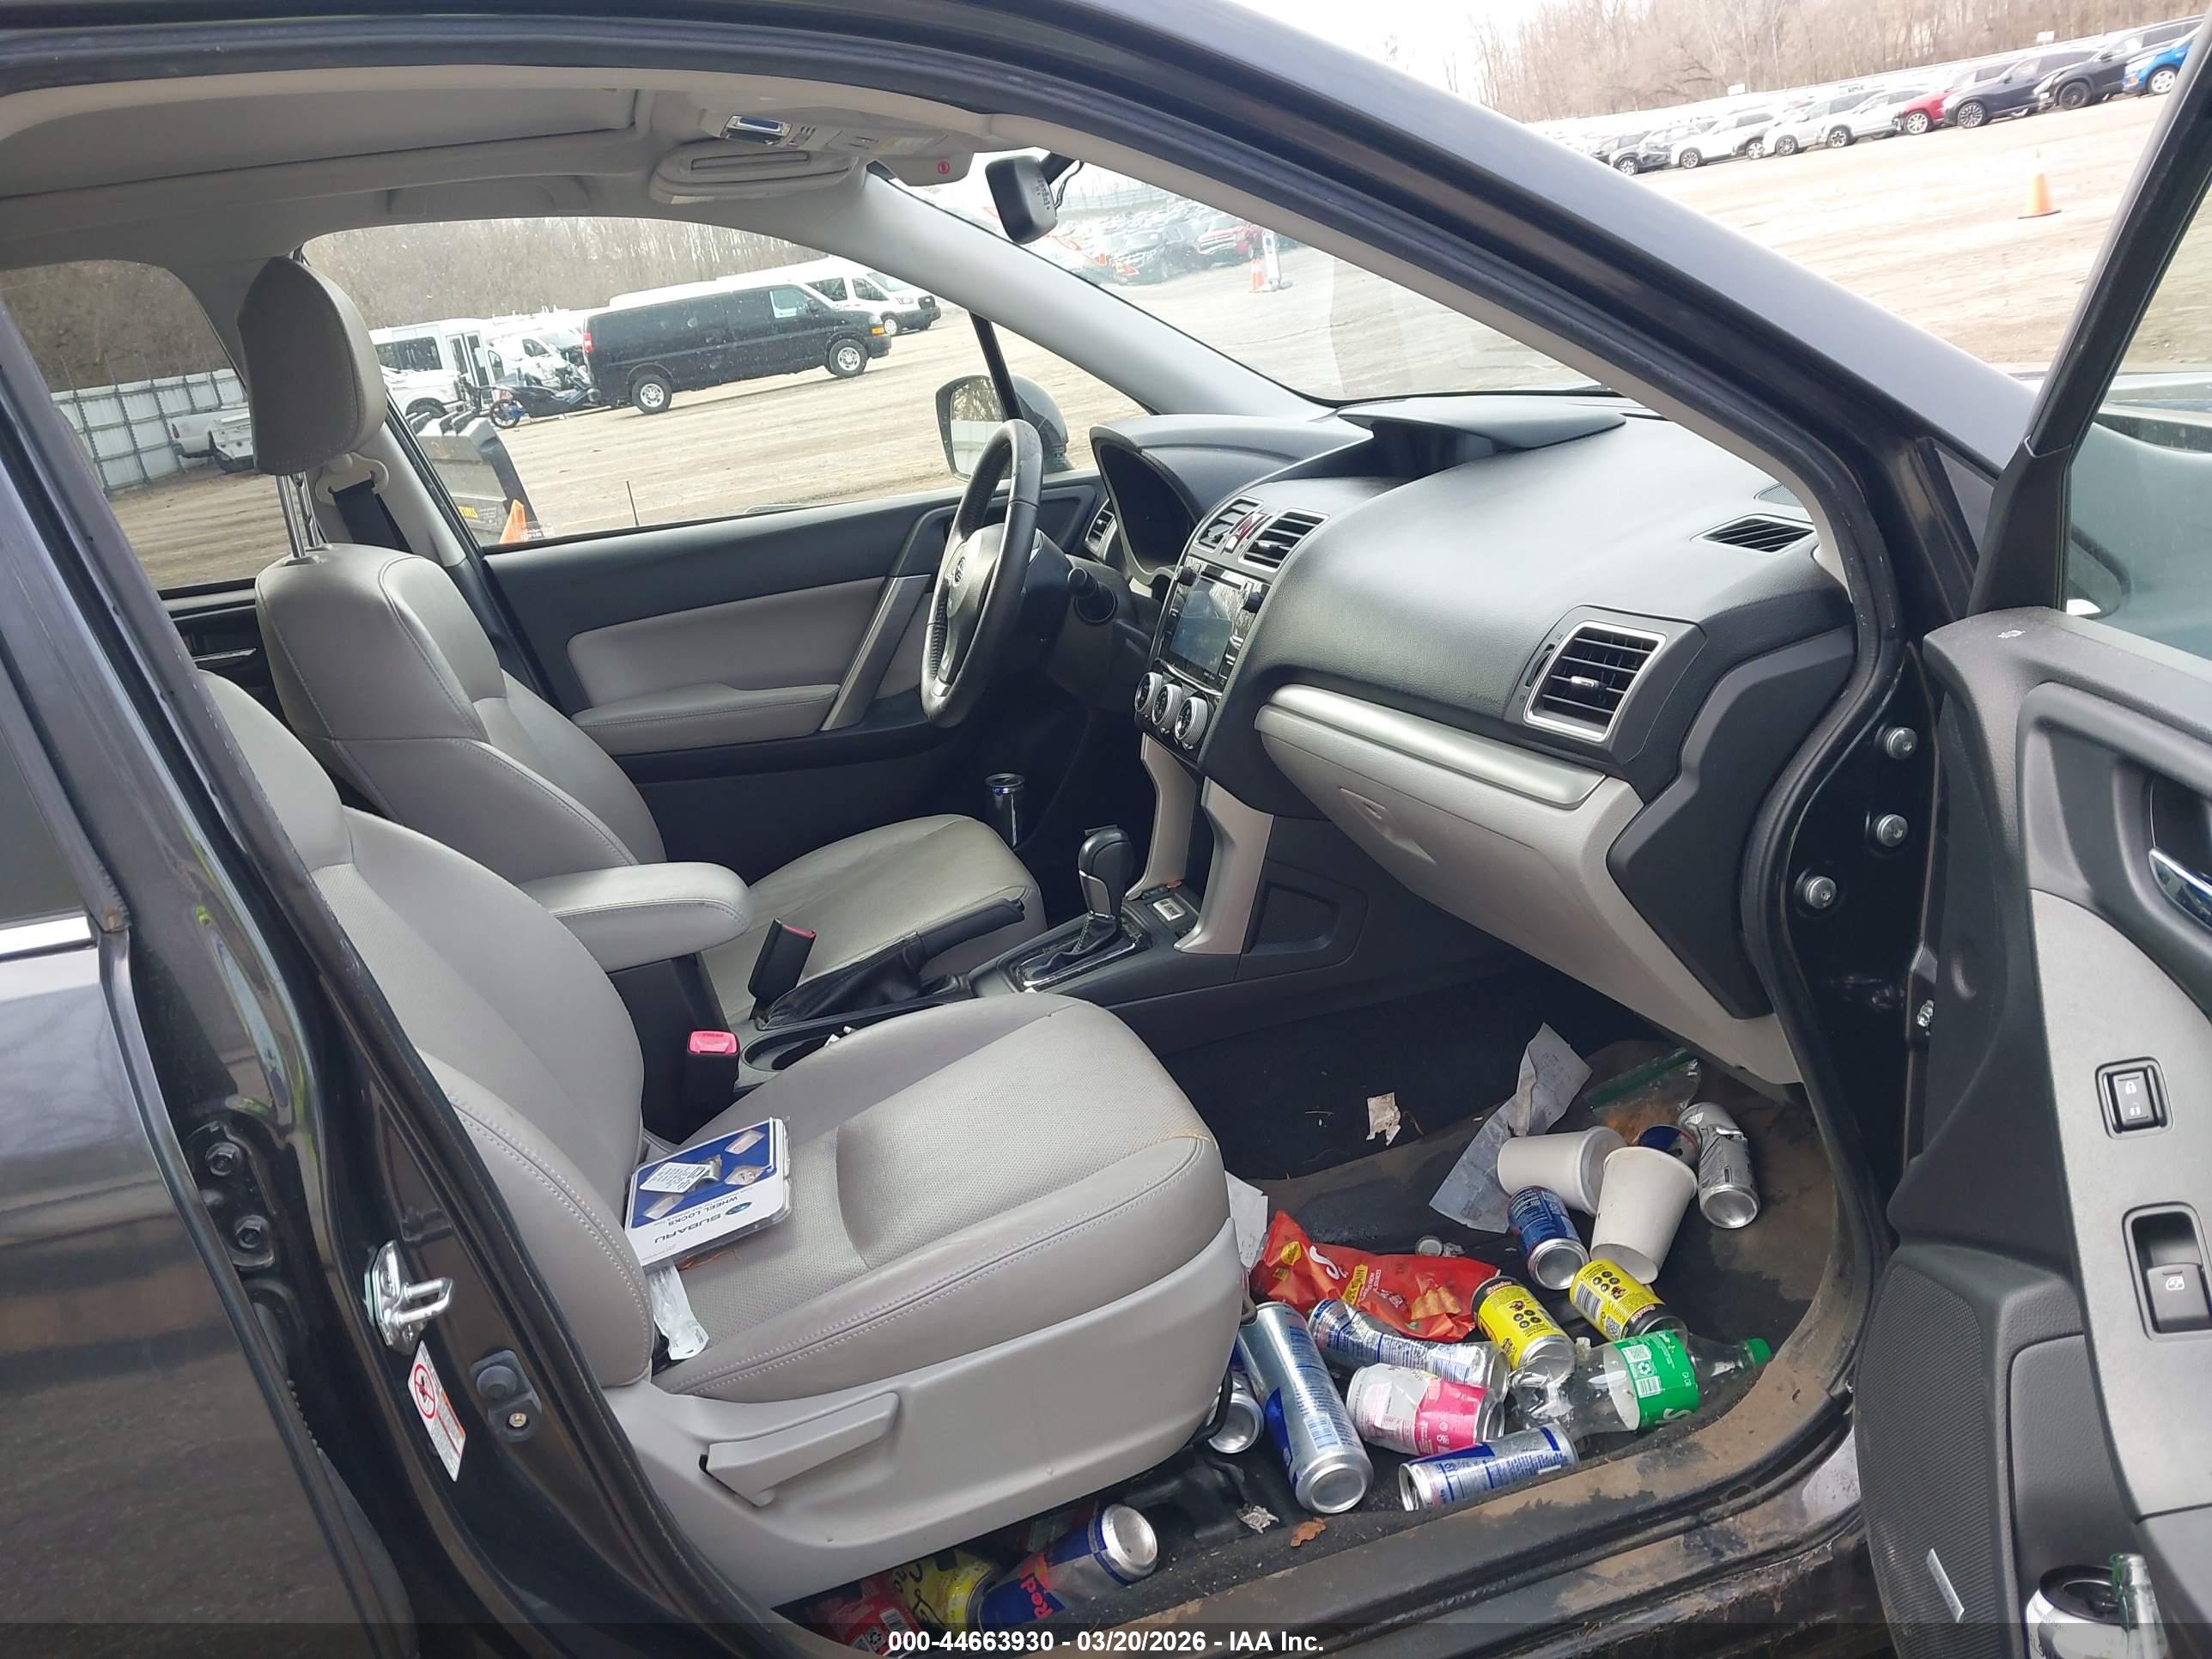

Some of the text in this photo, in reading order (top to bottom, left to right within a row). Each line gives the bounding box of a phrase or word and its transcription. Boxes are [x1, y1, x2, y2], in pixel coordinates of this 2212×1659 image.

[704, 1195, 738, 1212] WHEEL
[653, 1213, 721, 1243] SUBARU
[667, 1210, 702, 1227] LOCKS
[1020, 1575, 1054, 1620] Red
